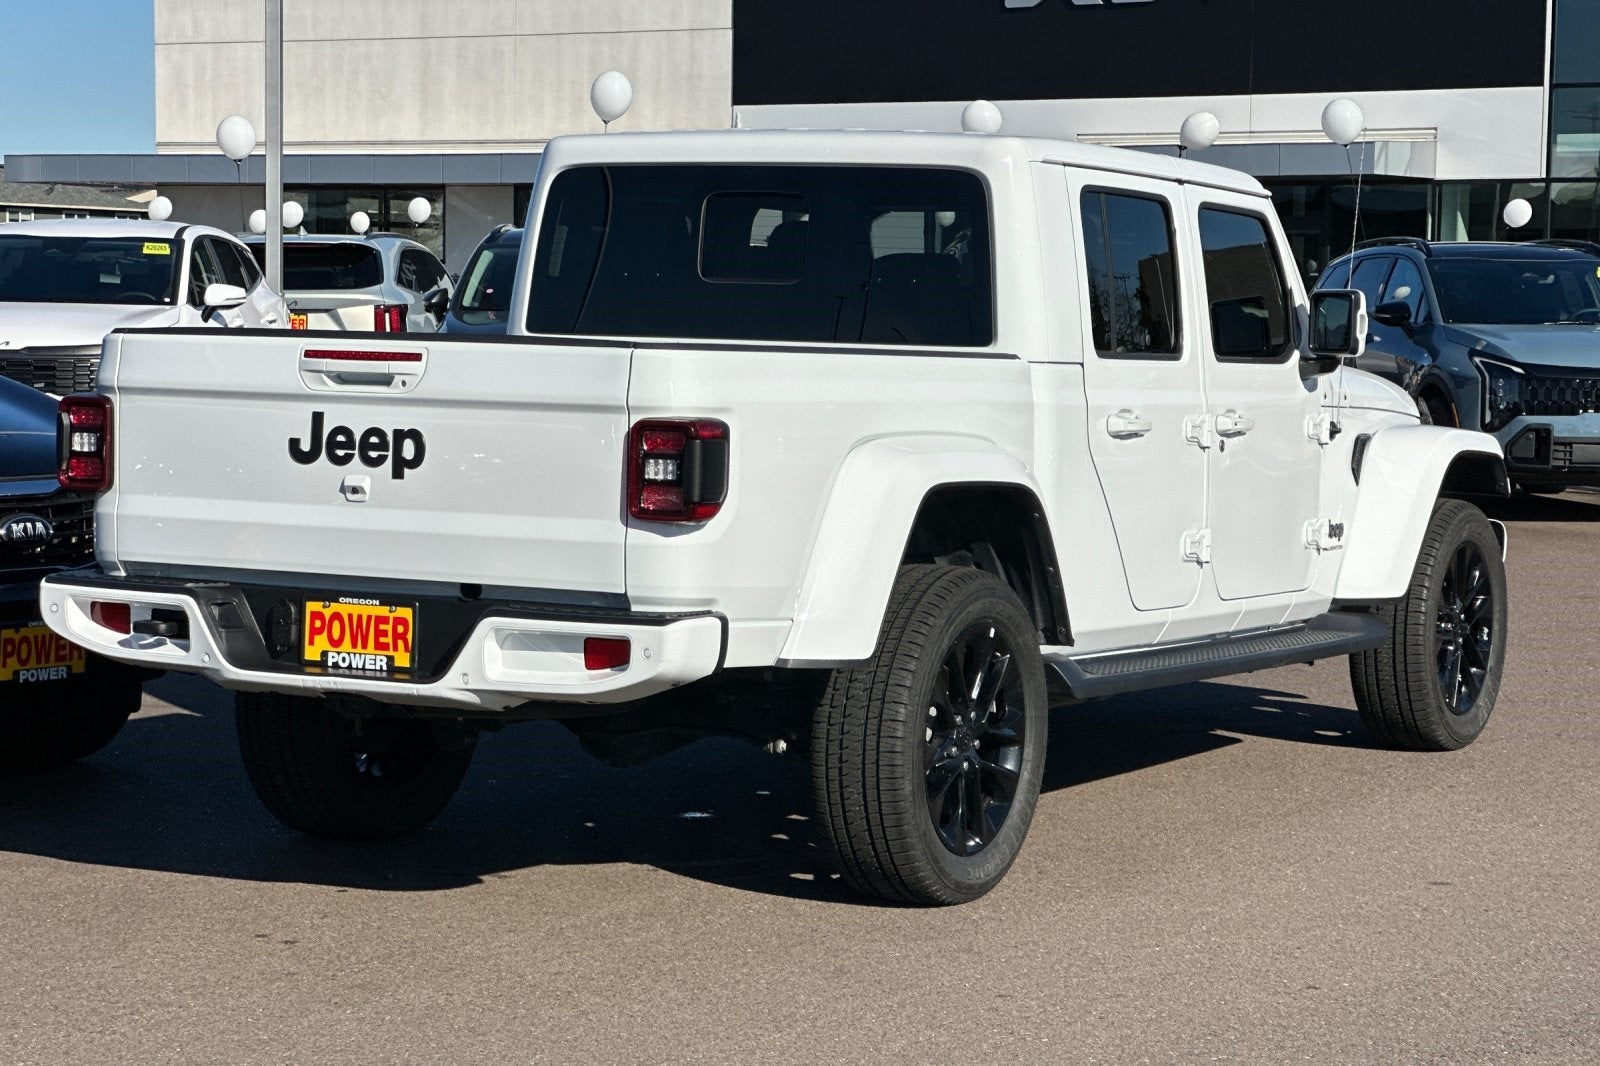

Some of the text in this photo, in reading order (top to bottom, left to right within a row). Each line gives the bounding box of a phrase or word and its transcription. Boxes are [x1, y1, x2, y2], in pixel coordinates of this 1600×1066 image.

[288, 410, 427, 480] Jeep
[10, 522, 48, 540] KIA
[339, 597, 380, 605] OREGON
[308, 610, 411, 653] POWER
[327, 652, 387, 670] POWER
[19, 666, 67, 683] POWER
